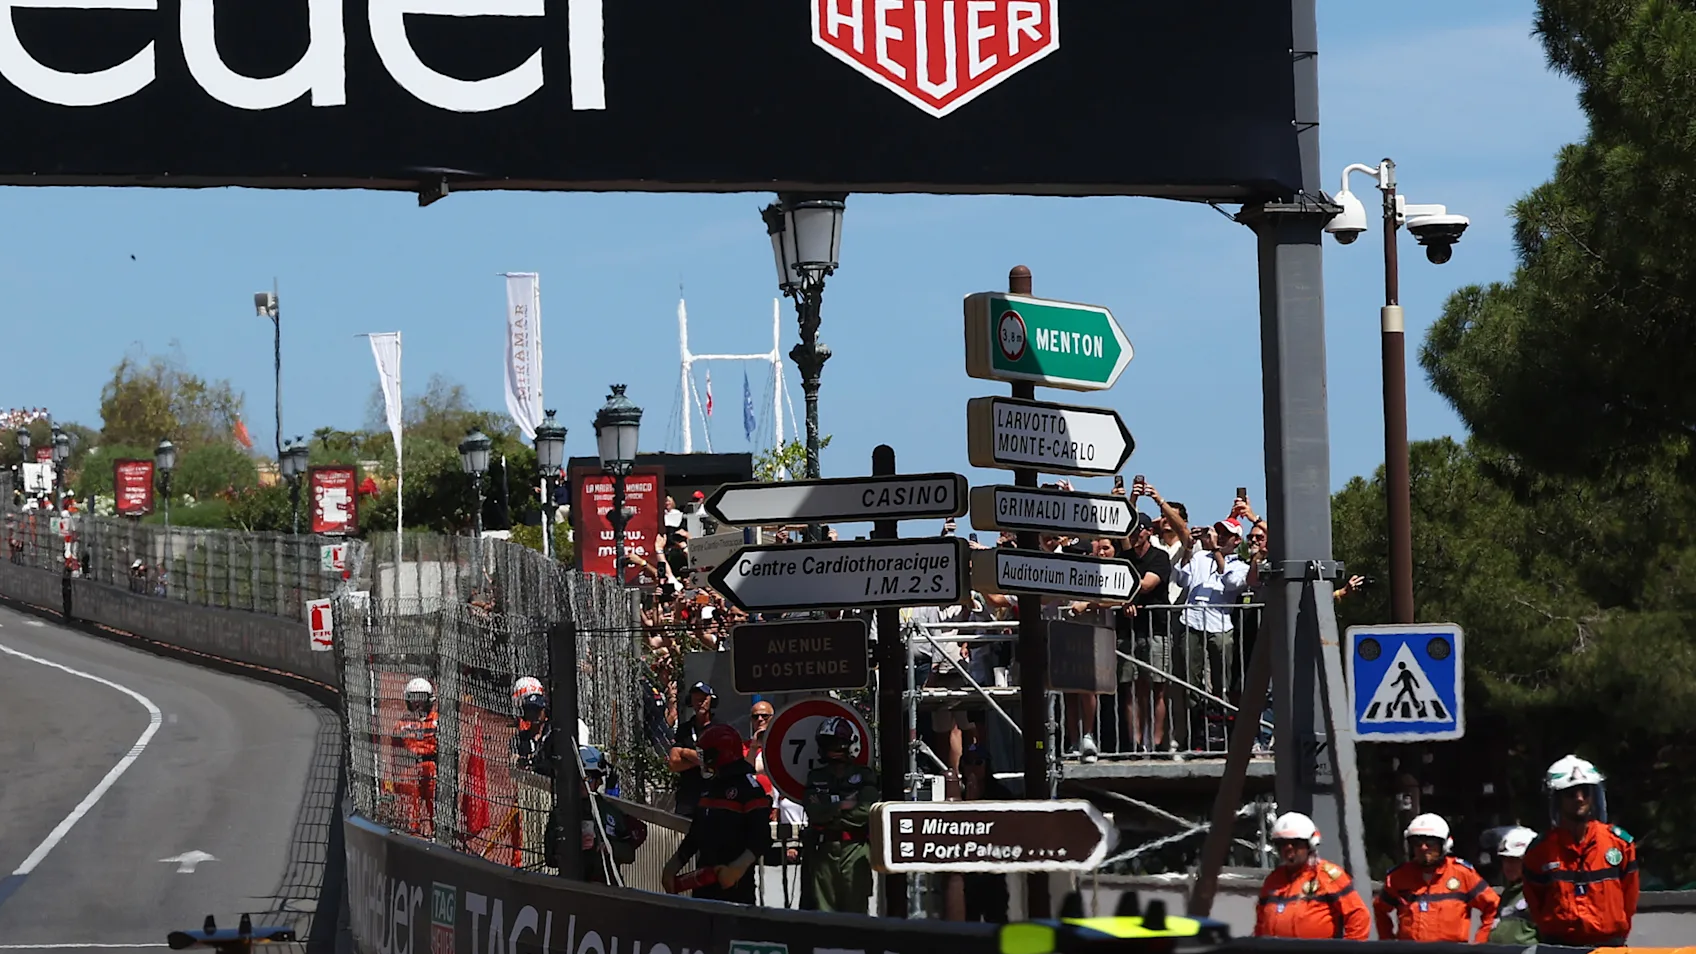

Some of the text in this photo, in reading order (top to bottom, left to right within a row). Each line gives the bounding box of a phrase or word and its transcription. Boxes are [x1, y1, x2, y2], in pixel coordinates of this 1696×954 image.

[827, 0, 1044, 101] HEUER
[514, 304, 526, 401] MIRAMAR
[1035, 327, 1103, 358] MENTON
[998, 409, 1066, 435] LARVOTTO
[998, 433, 1095, 461] MONTE-CARLO
[861, 485, 948, 508] CASINO
[999, 497, 1119, 525] GRIMALDI FORUM
[600, 530, 645, 541] ww.
[738, 552, 950, 577] Centre Cardiothoracique
[1002, 561, 1126, 590] Auditorium Rainier III
[864, 574, 950, 596] I.M.2.S.
[767, 637, 832, 654] AVENUE
[752, 659, 850, 679] D'OSTENDE
[921, 818, 994, 836] Miramar
[922, 841, 1022, 860] Port Palace
[434, 889, 454, 923] TAG
